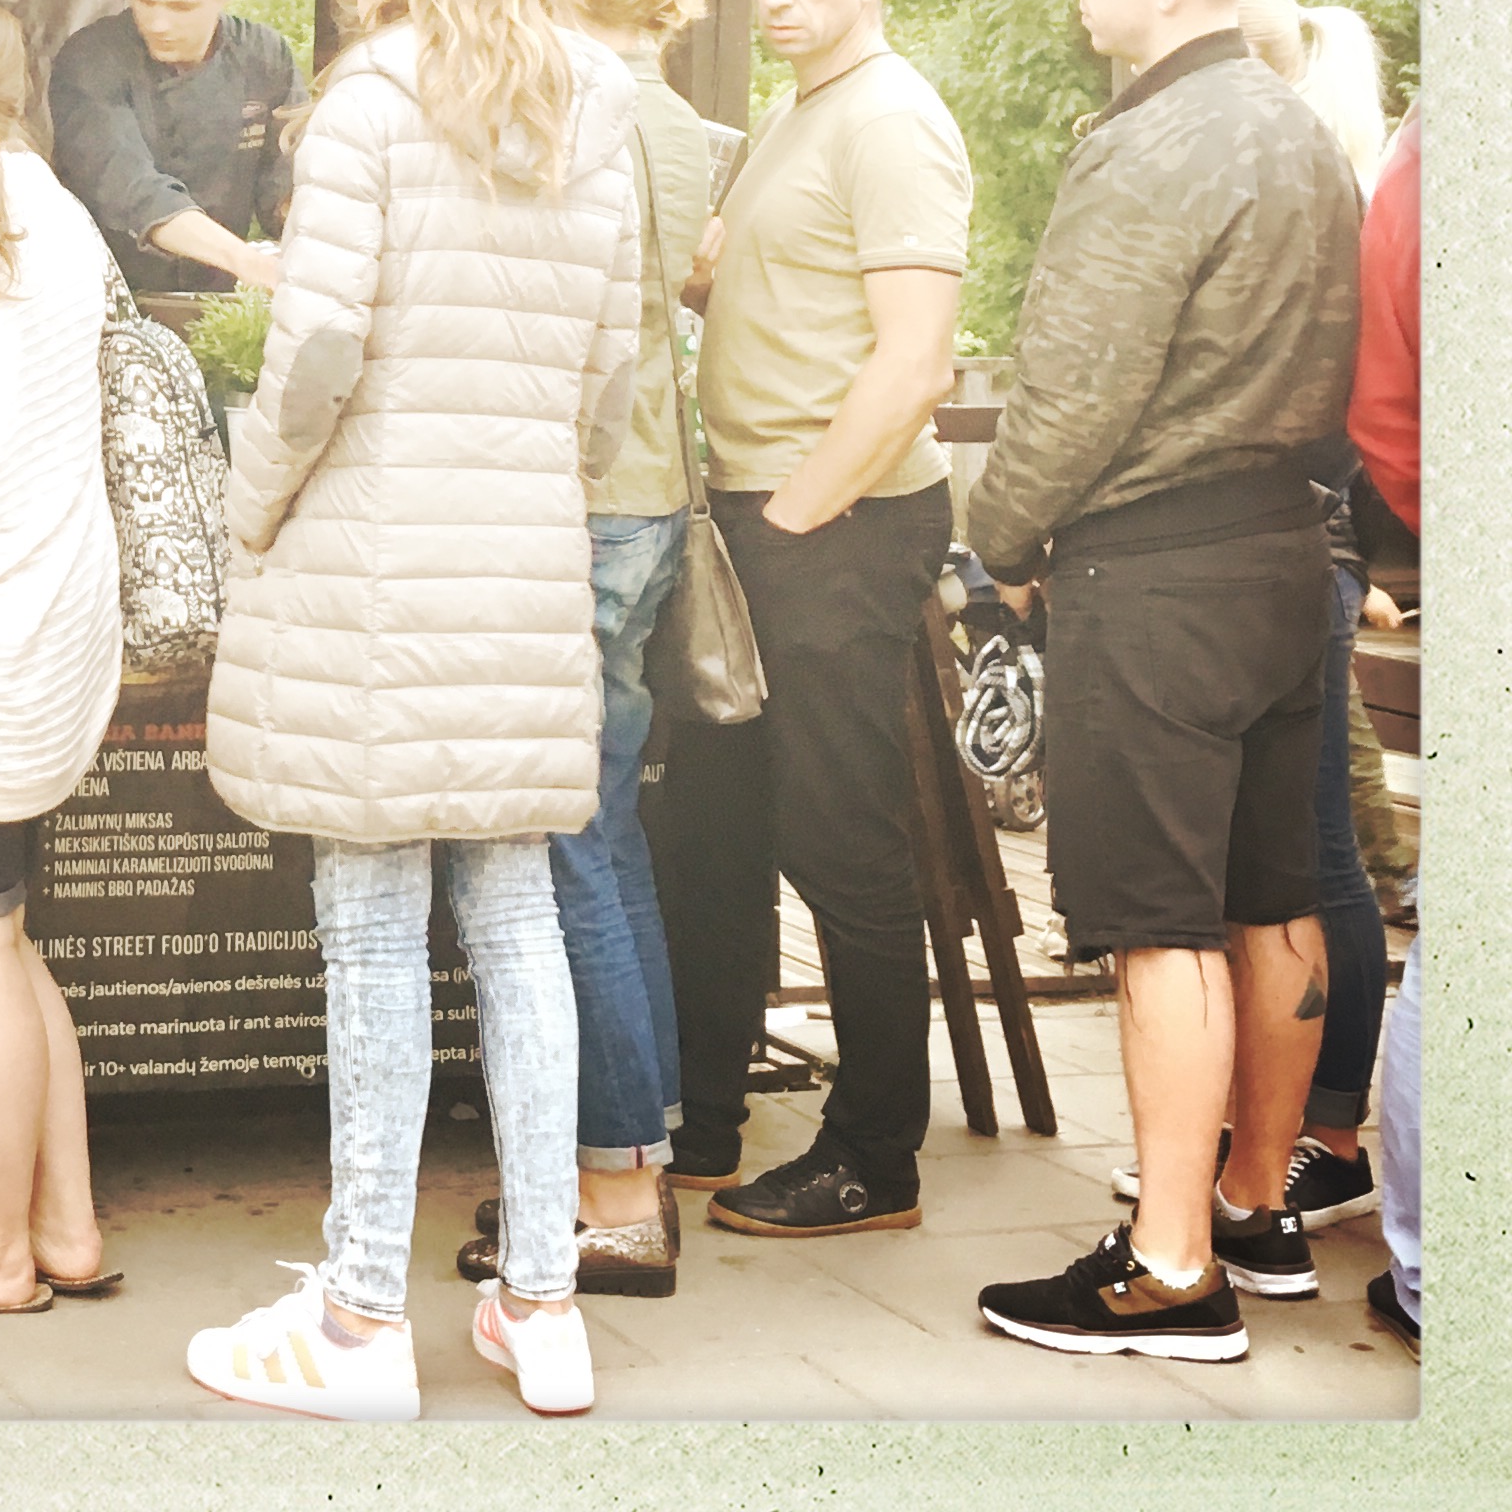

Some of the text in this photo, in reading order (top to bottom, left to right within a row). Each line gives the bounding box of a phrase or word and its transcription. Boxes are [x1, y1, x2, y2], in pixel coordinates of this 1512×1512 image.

[103, 749, 165, 772] VIŠTIENA
[55, 812, 173, 832] ŽALUMYNŲ MIKSAS
[54, 831, 270, 854] MEKSIKIETIŠKOS KOPŪSTŲ SALOTOS
[54, 852, 274, 876] NAMINIAI KARAMELIZUOTI SVOGŪNAI
[54, 880, 105, 899] NAMINIS
[136, 877, 195, 896] PADAŽAS
[92, 934, 155, 957] STREET
[225, 929, 318, 953] TRADICIJOS
[234, 973, 301, 991] dešrelės
[140, 1018, 226, 1035] marinuota
[229, 1016, 240, 1031] ir
[243, 1014, 271, 1030] ant
[98, 1060, 126, 1076] 10+
[129, 1058, 196, 1076] valandų
[200, 1055, 259, 1073] žemoje
